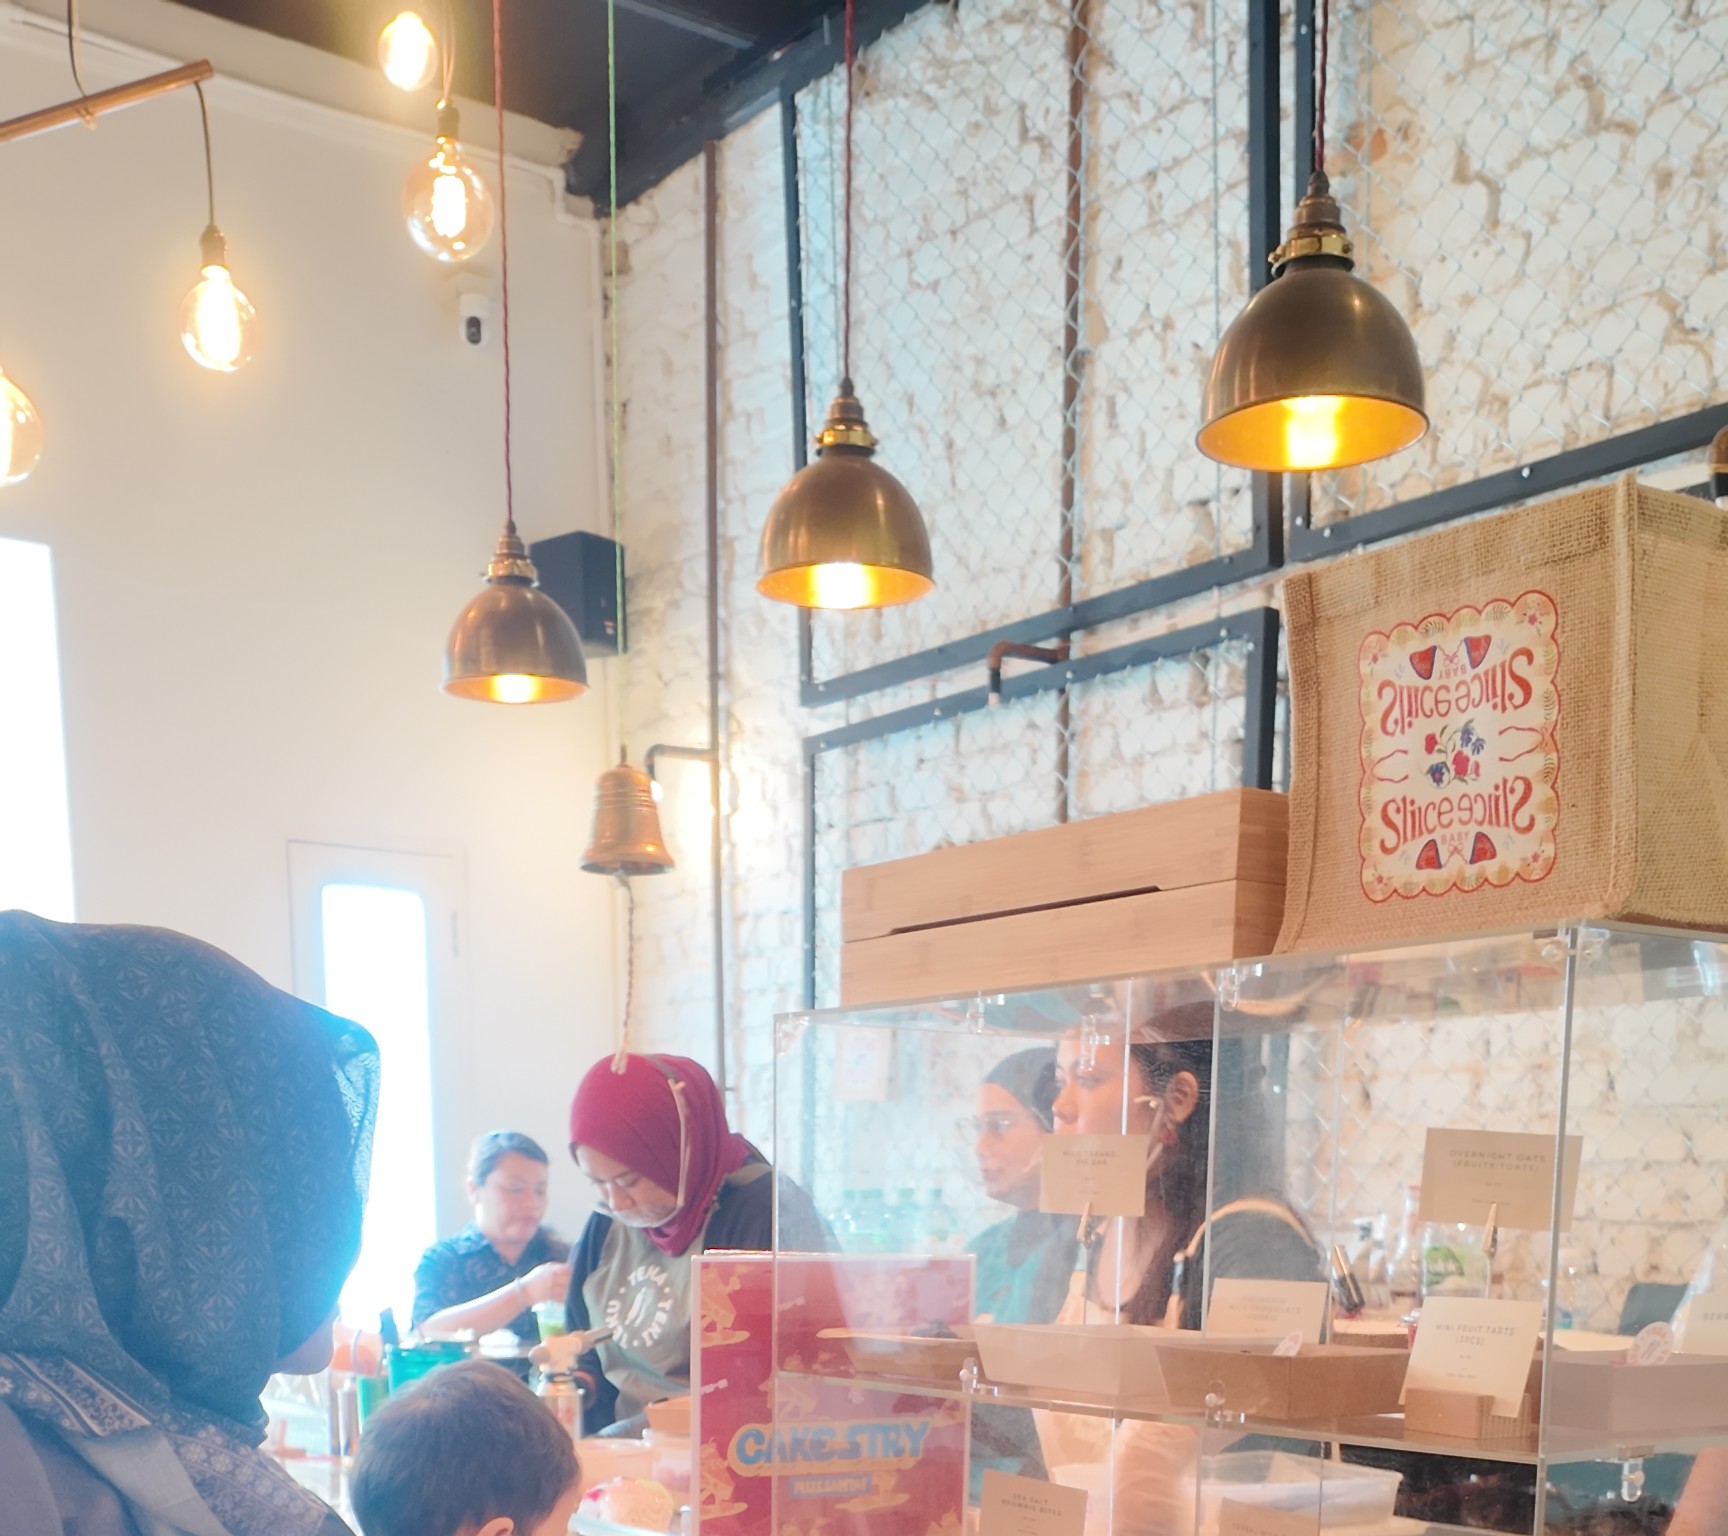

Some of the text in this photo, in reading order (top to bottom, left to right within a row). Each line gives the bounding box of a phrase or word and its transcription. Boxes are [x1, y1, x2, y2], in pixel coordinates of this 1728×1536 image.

[1441, 830, 1470, 846] BABY
[1449, 1150, 1546, 1163] OVERNIGHT OATS
[1457, 1323, 1483, 1333] FRUIT
[1486, 1325, 1515, 1336] TARTS
